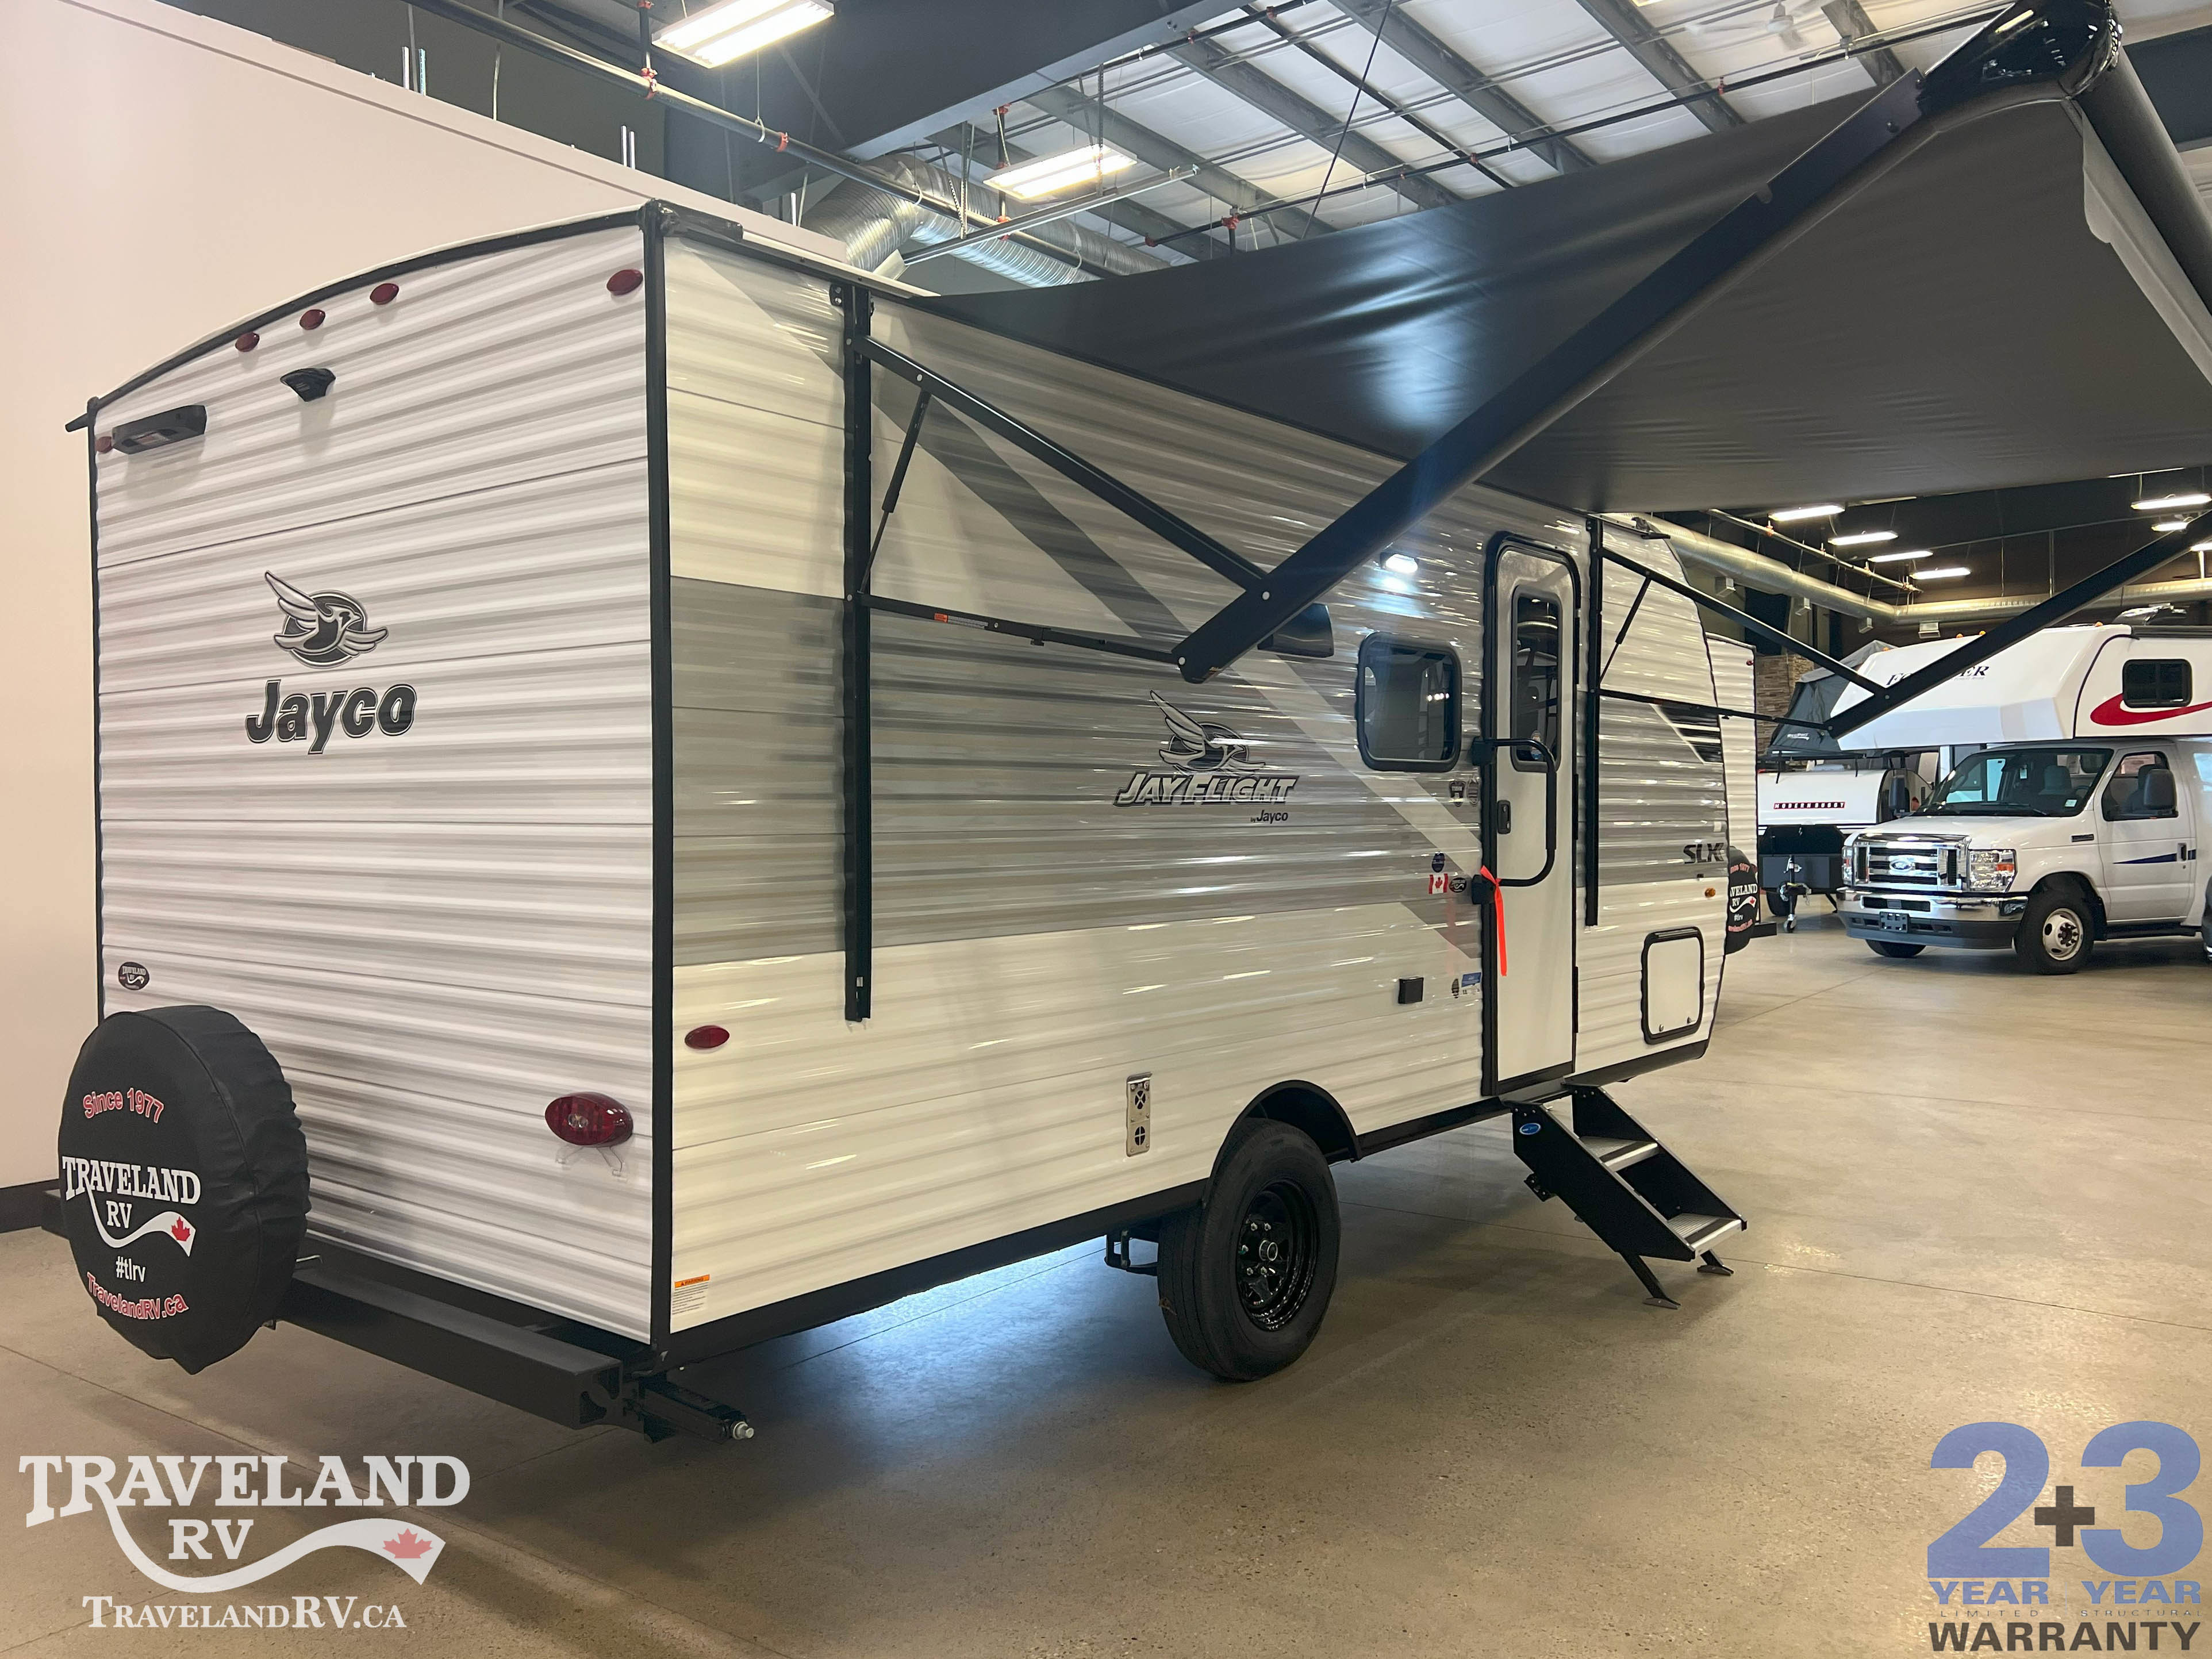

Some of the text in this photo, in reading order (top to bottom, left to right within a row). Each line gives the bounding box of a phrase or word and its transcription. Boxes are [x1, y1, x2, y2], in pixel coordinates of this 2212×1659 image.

[245, 679, 417, 755] Jayco
[1257, 810, 1288, 824] Jayco
[1683, 843, 1725, 864] SLK
[1732, 897, 1740, 907] RV
[83, 1087, 164, 1124] Since 1977
[62, 1155, 201, 1205] TRAVELAND
[106, 1200, 132, 1229] RV
[116, 1255, 146, 1282] #tlrv
[87, 1271, 189, 1320] TravelandRV.ca
